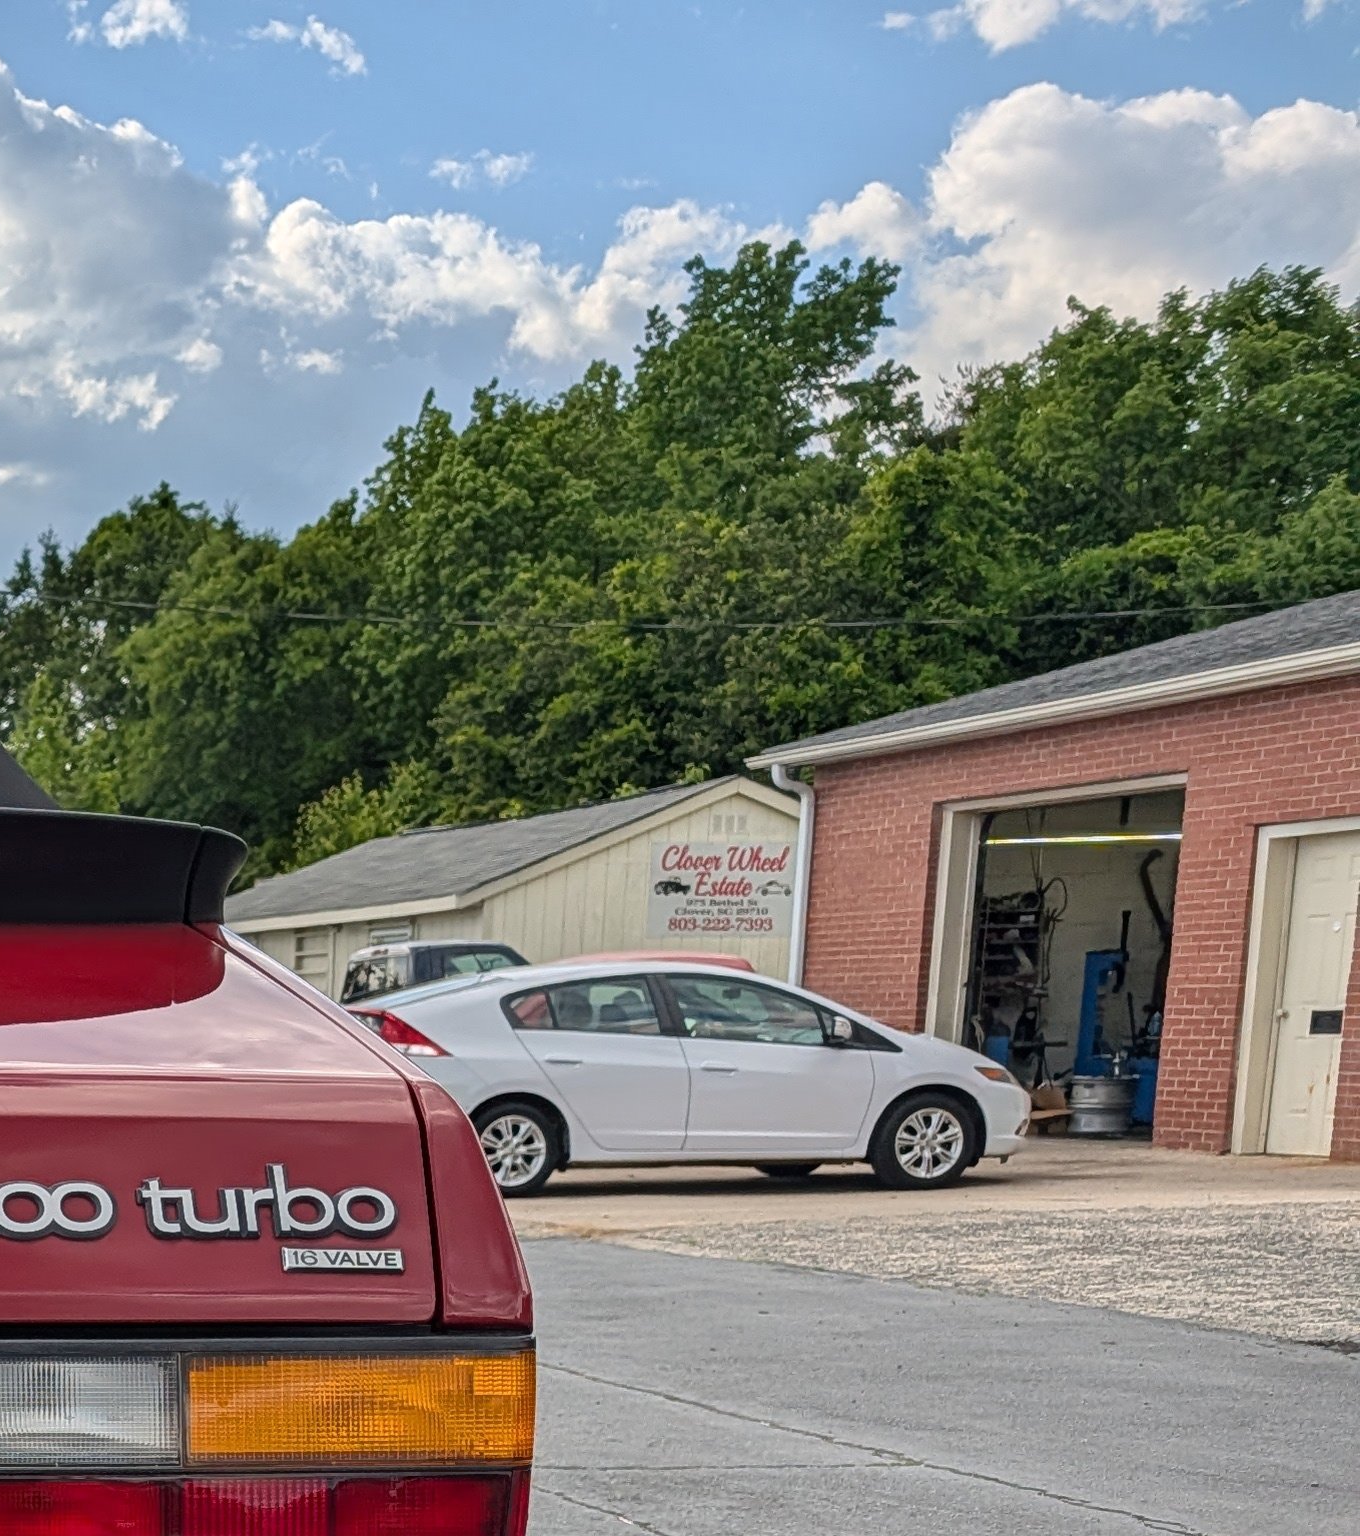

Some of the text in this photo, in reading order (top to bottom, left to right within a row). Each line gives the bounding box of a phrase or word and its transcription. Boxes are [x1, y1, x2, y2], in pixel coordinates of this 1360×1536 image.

[661, 845, 790, 872] Clover Wheel
[694, 872, 753, 897] Estate
[668, 917, 773, 931] 803-222-7393
[136, 1163, 398, 1238] turbo
[291, 1250, 398, 1267] 16 VALVE
